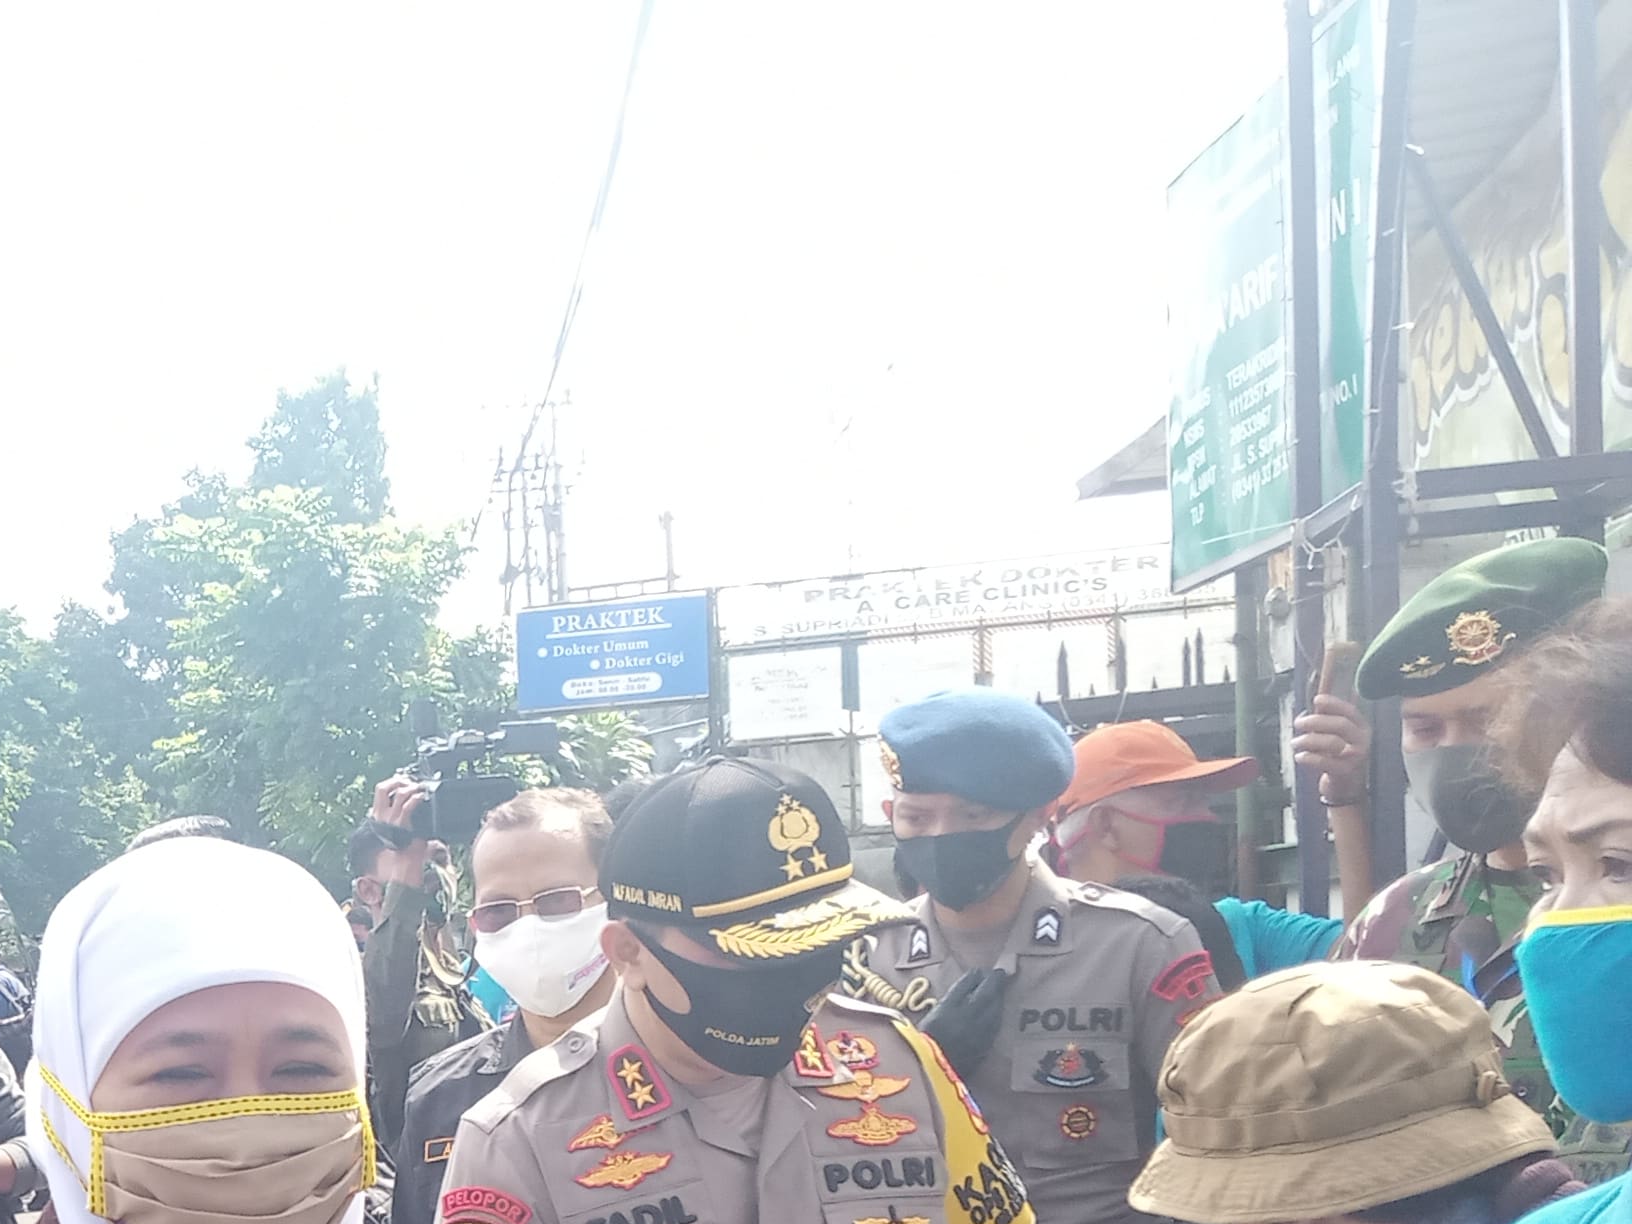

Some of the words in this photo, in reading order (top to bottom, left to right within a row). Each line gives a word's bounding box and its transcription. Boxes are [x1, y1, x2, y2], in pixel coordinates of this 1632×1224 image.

[894, 589, 972, 610] CARE
[982, 577, 1109, 601] CLINIC'S
[551, 605, 666, 634] PRAKTEK
[552, 642, 600, 658] Dokter
[603, 639, 649, 653] Umum
[604, 654, 653, 670] Dokter
[655, 651, 685, 667] Gigi
[1019, 1006, 1124, 1032] POLRI
[705, 1026, 746, 1046] POLDA
[745, 1035, 781, 1047] JATIM
[822, 1156, 936, 1193] POLRI
[445, 1189, 522, 1222] PELOPOR
